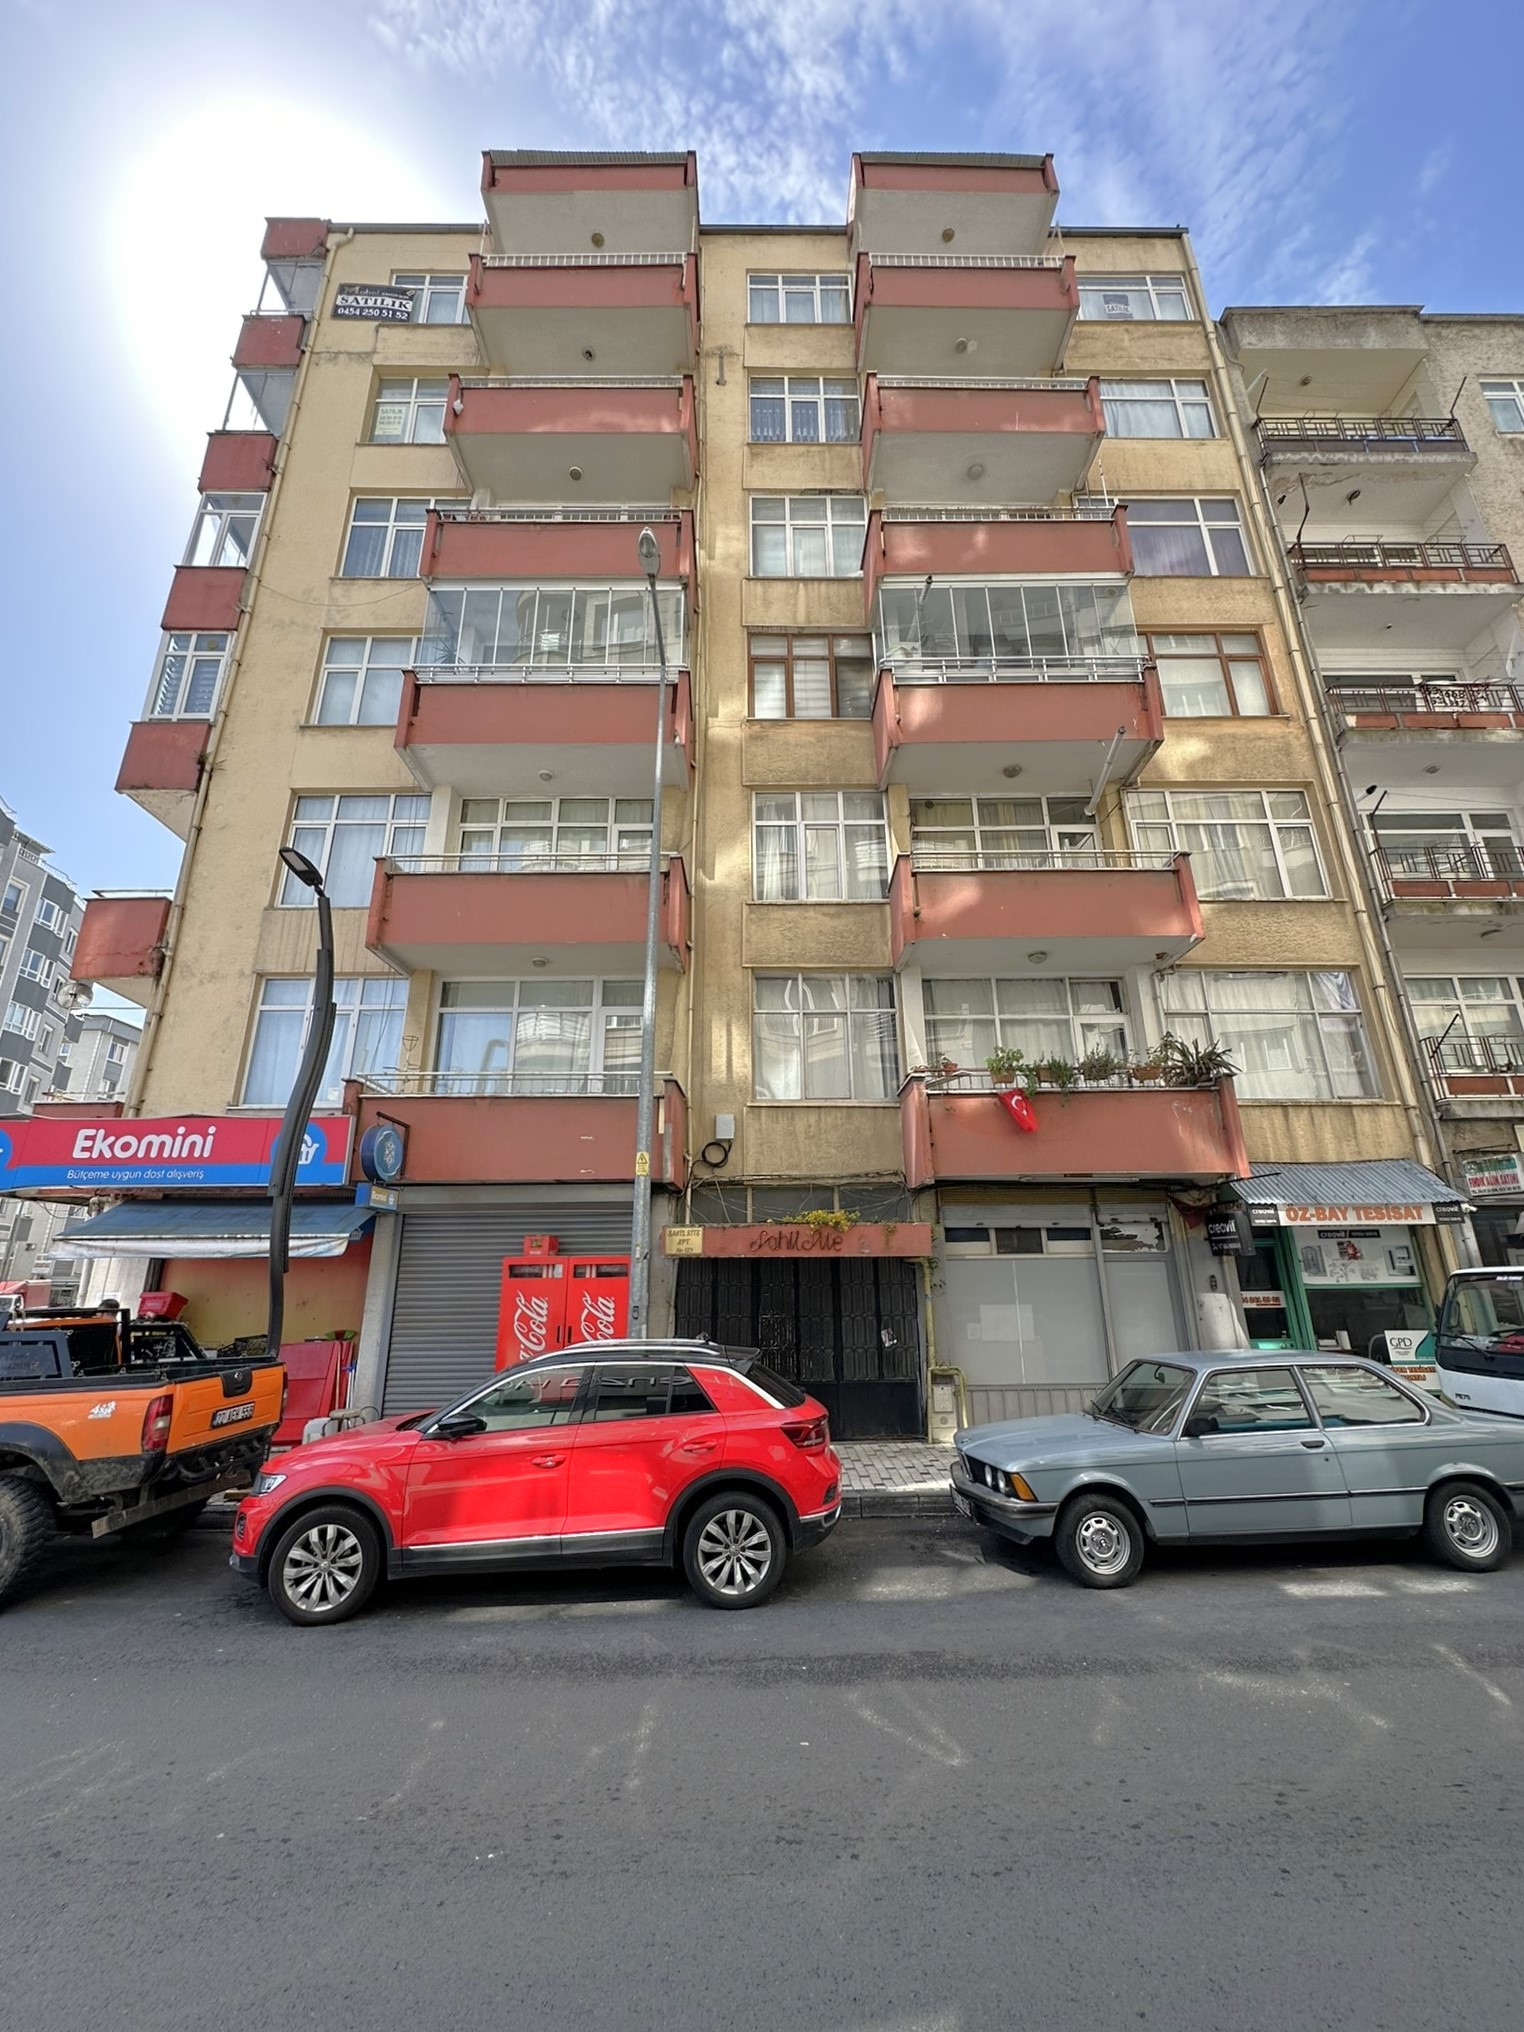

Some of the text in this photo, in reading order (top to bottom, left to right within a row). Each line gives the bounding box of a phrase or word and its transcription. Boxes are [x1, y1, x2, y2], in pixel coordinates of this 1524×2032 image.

[340, 295, 411, 310] SATILIK
[337, 307, 409, 320] 0454 250 51 52
[72, 1125, 217, 1159] Ekomini
[67, 1167, 205, 1181] Bütçeme uygun dost alışveriş
[1285, 1203, 1423, 1222] ÖZ-BAY TESİSAT
[1389, 1336, 1413, 1347] GPD
